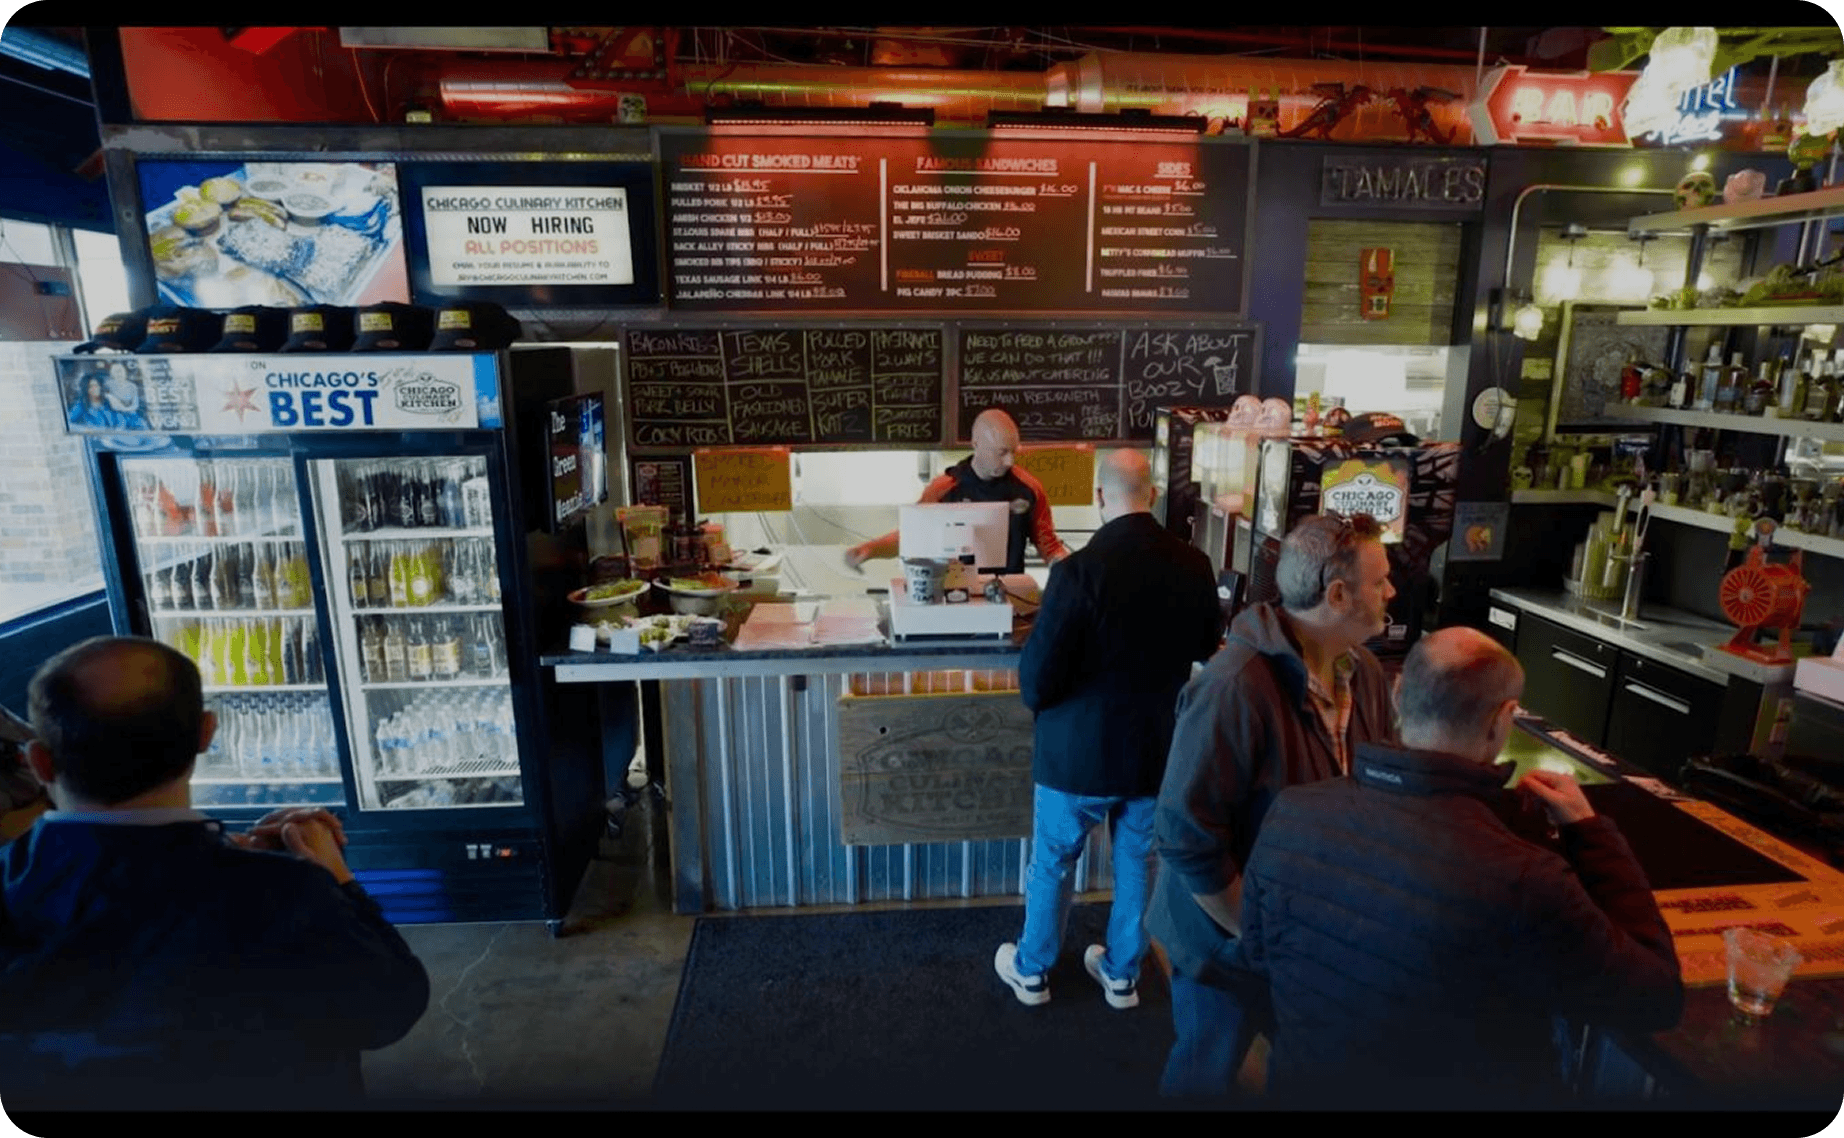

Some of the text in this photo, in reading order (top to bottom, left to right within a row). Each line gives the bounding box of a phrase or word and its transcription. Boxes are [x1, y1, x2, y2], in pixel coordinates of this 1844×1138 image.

[1513, 87, 1613, 128] BAR
[721, 154, 749, 168] CUT
[752, 154, 811, 168] SMOKED
[977, 158, 1059, 171] SANDWICHES
[1157, 162, 1191, 175] SIDES
[1327, 163, 1484, 201] TAMALES
[893, 185, 943, 194] OKLAHOMA
[944, 185, 972, 194] ONION
[973, 185, 1037, 196] CHEESEBURGER
[1117, 185, 1135, 194] MAC
[1142, 185, 1171, 195] CHEESE
[426, 197, 624, 211] CHICAGO CULINARY KITCHEN
[671, 197, 703, 207] PULLED
[703, 197, 728, 207] PORK
[893, 201, 909, 210] THE
[910, 201, 924, 210] BIG
[926, 201, 964, 210] BUFFALO
[965, 201, 1002, 210] CHICKEN
[1136, 206, 1162, 215] BEANS
[467, 216, 595, 234] NOW HIRING
[672, 214, 698, 223] AMISH
[700, 214, 738, 223] CHICKEN
[893, 215, 926, 224] EL JEFE
[710, 228, 736, 237] SPARE
[737, 228, 755, 237] RIBS
[893, 231, 920, 240] SWEET
[922, 231, 955, 240] BRISKET
[956, 231, 985, 240] SANDO
[1101, 227, 1186, 236] MEXICAN STREET CORN
[464, 240, 600, 255] ALL POSITIONS
[673, 242, 697, 251] BACK
[697, 242, 724, 251] ALLEY
[726, 242, 755, 251] STICKY
[757, 242, 775, 251] RIBS
[1132, 248, 1206, 257] CORNBREAD MUFFIN
[598, 261, 610, 269] TO
[674, 257, 709, 266] SMOKED
[711, 257, 724, 266] RIB
[725, 257, 742, 266] TIPS
[675, 275, 702, 284] TEXAS
[703, 275, 741, 284] SAUSAGE
[742, 275, 763, 284] LINK
[936, 270, 964, 279] BREAD
[965, 270, 1003, 280] PUDDING
[725, 289, 764, 298] CHEDDAR
[765, 289, 786, 298] LINK
[896, 288, 912, 297] PIG
[913, 288, 943, 297] CANDY
[629, 331, 678, 354] BACON
[725, 331, 791, 355] TEXAS
[810, 331, 868, 350] PULLED
[966, 334, 999, 349] NEED
[1014, 334, 1045, 348] FEED
[1046, 335, 1058, 348] A
[1131, 331, 1181, 359] ASK
[1184, 334, 1248, 354] ABOUT
[964, 352, 987, 366] WE
[990, 352, 1020, 364] CAN
[1023, 352, 1046, 365] DO
[1047, 352, 1085, 364] THAT
[1143, 356, 1203, 379] OUR
[265, 372, 378, 388] CHICAGO'S
[1041, 368, 1110, 381] CATERING
[399, 386, 456, 395] CHICAGO
[740, 385, 783, 400] OLD
[1128, 378, 1206, 400] BOOZY
[268, 390, 378, 426] BEST
[401, 400, 457, 408] KITCHEN
[812, 391, 869, 412] SUPER
[551, 411, 567, 434] The
[887, 422, 933, 440] FRIES
[553, 454, 577, 477] Green
[1332, 491, 1395, 501] CHICAGO
